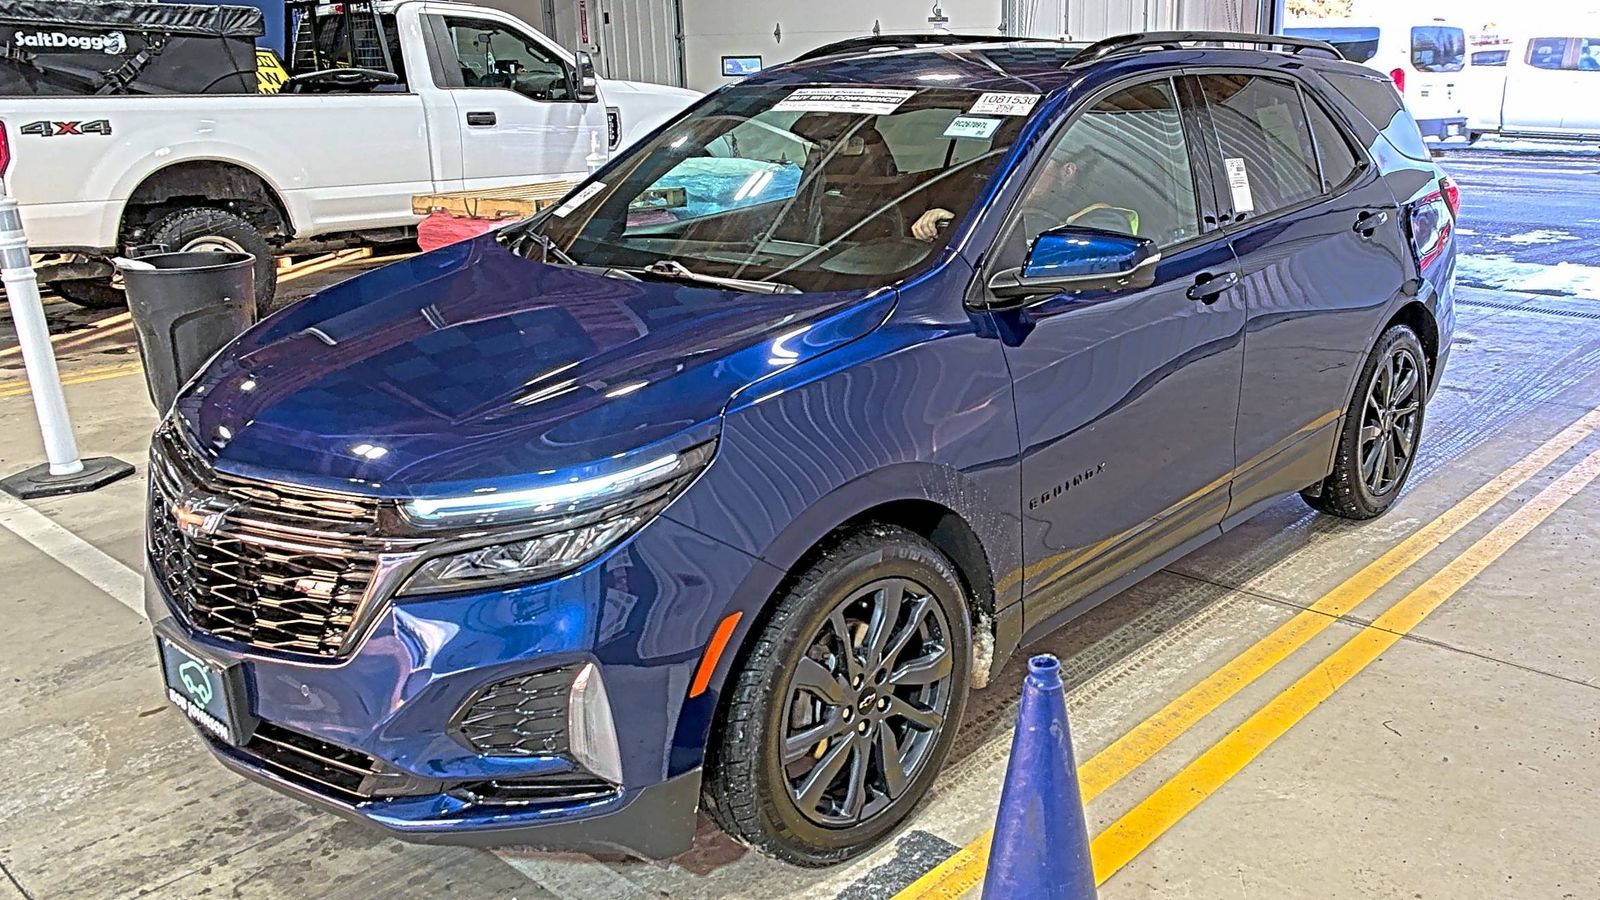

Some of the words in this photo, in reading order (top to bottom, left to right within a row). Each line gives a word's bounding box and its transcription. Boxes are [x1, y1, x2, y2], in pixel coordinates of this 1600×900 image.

[14, 30, 104, 50] SaltDogg
[833, 95, 903, 104] CONFIDENCE!
[983, 94, 1038, 105] 1081530
[1029, 461, 1106, 510] EQUINOX
